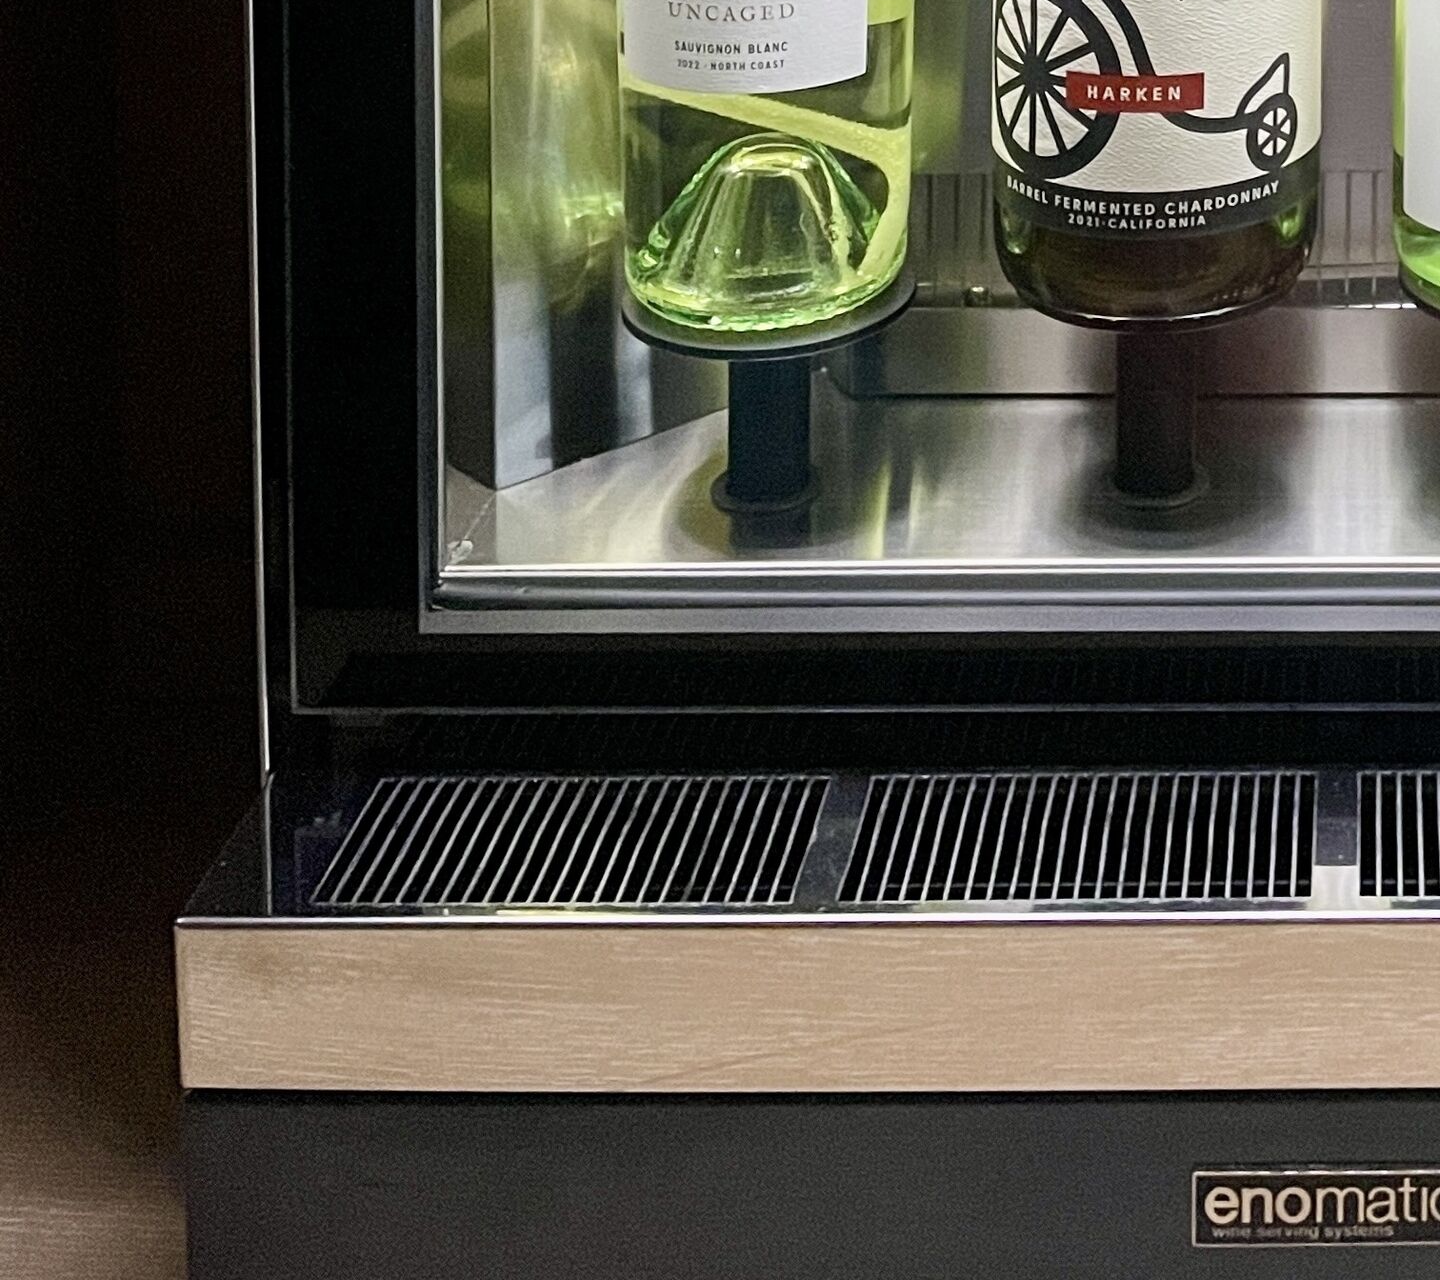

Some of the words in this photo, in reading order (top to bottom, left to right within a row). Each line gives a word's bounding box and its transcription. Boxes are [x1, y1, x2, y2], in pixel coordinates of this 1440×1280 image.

[668, 1, 795, 22] UNCAGED
[674, 40, 741, 55] SAUVIGNON
[748, 41, 788, 54] BLANC
[677, 59, 700, 70] 2022
[710, 61, 746, 71] NORTH
[750, 59, 785, 70] COAST
[1087, 85, 1182, 102] HARKEN
[1007, 175, 1048, 204] BARREL
[1054, 194, 1156, 216] FERMENTED
[1164, 180, 1280, 215] CHARDONNAY
[1324, 1225, 1394, 1240] systems
